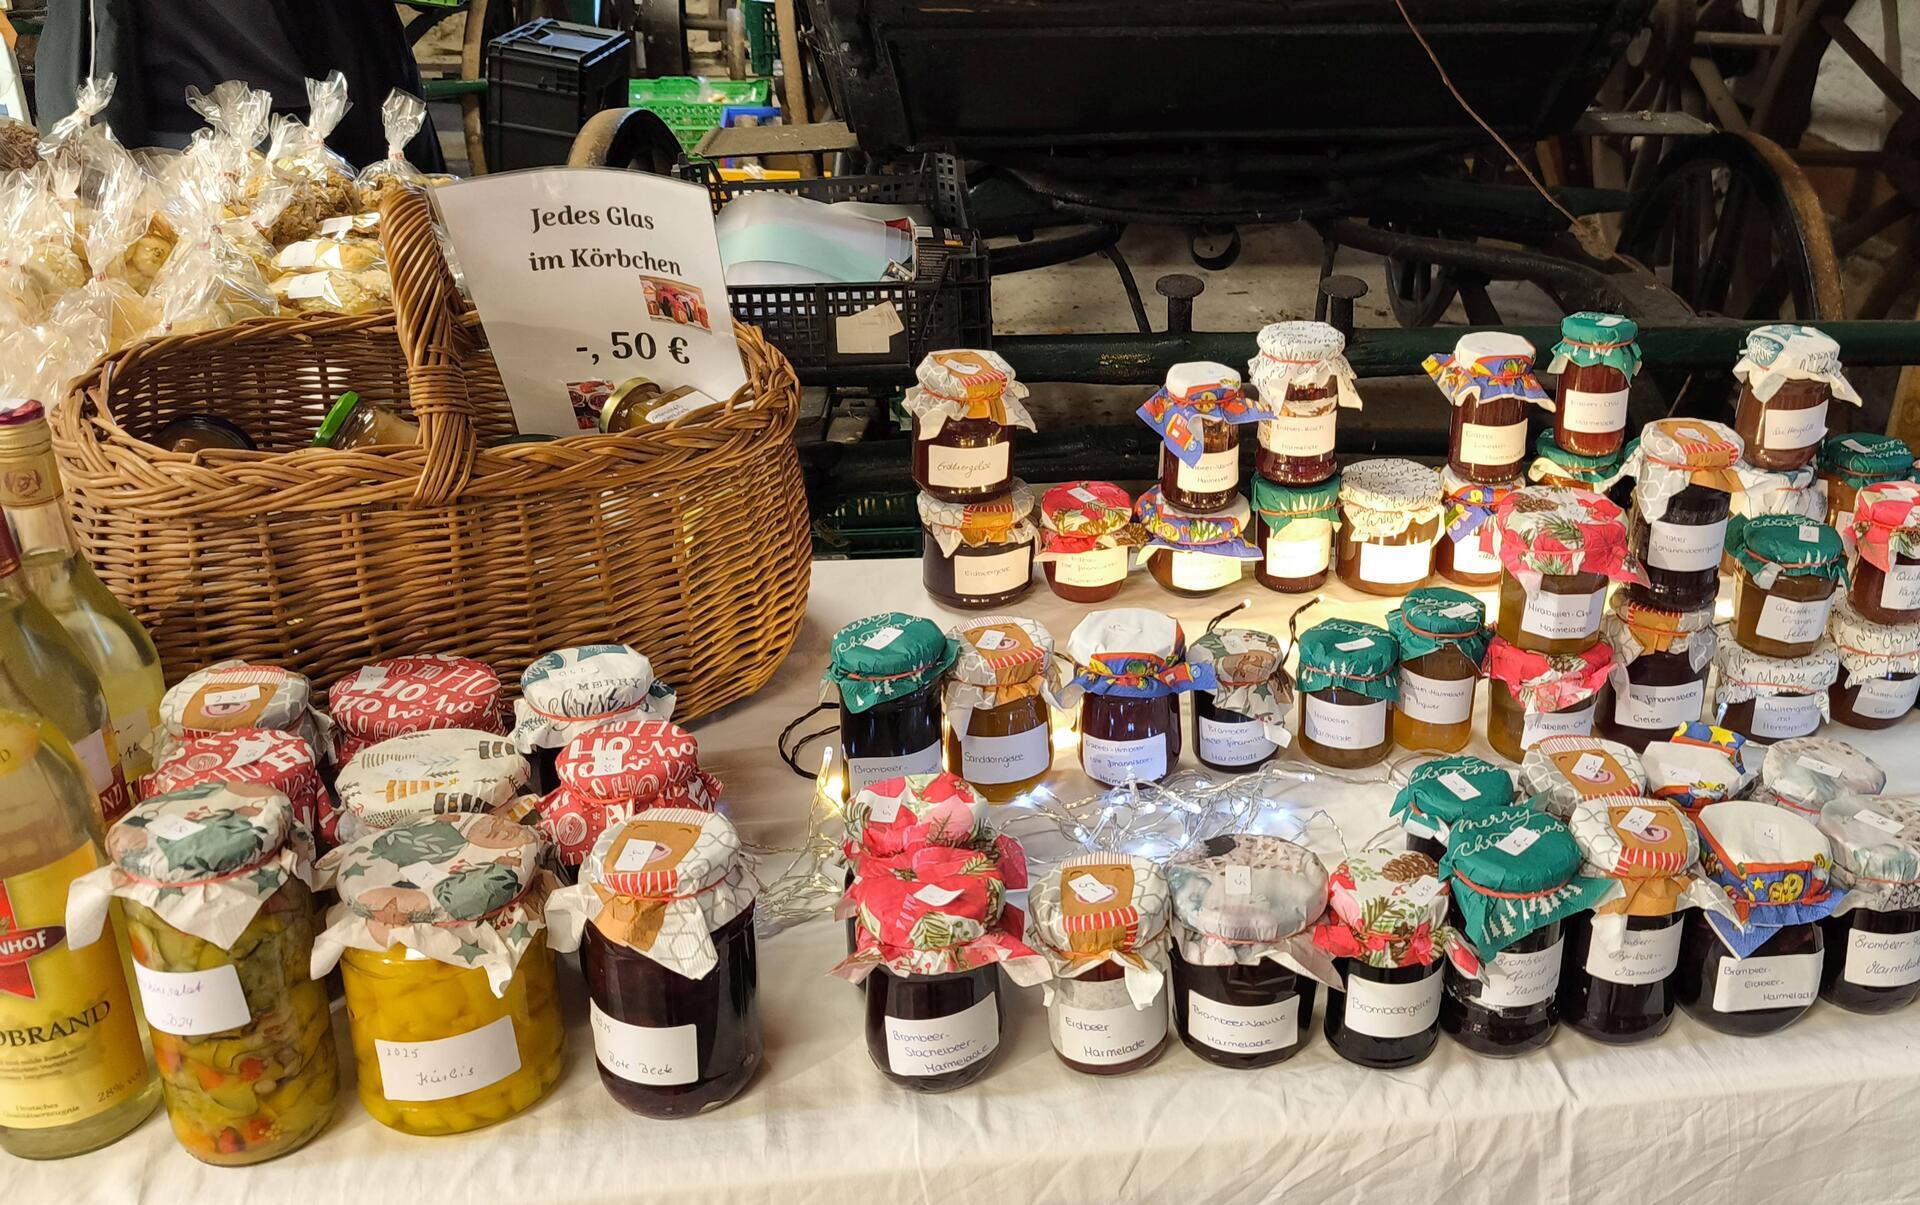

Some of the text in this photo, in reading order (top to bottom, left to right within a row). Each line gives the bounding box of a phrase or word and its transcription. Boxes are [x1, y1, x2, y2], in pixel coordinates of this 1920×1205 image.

[531, 204, 655, 234] Jedes Glas
[528, 248, 683, 277] im Körbchen
[610, 330, 658, 361] 50
[577, 677, 641, 691] MERRY
